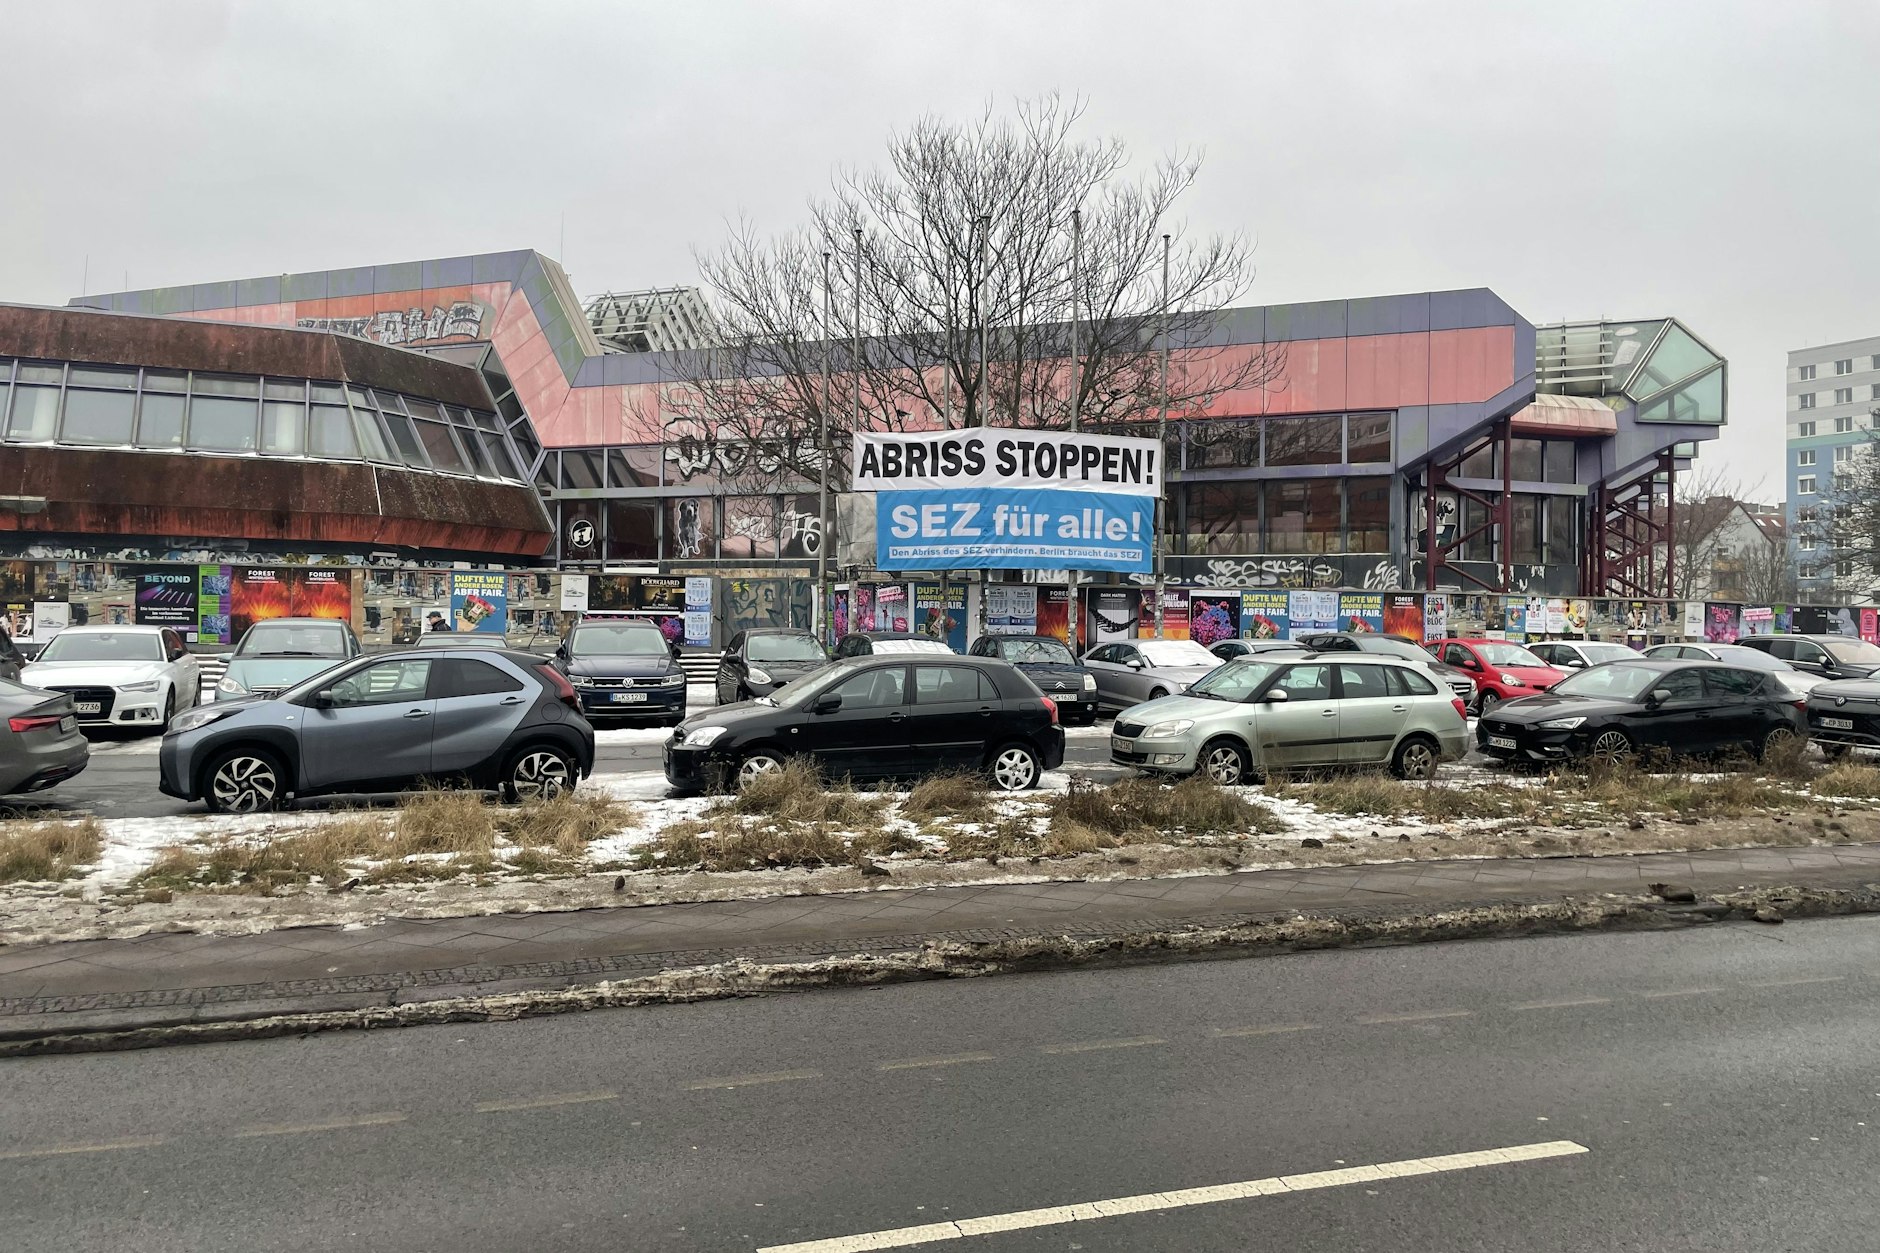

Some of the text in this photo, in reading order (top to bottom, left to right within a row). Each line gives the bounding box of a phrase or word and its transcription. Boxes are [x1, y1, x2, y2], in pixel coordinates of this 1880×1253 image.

[859, 439, 985, 478] ABRISS
[996, 440, 1154, 484] STOPPEN!
[891, 503, 1141, 542] SEZ für alle!
[912, 548, 940, 556] Abriss
[986, 547, 1037, 555] verhindern.
[1040, 548, 1065, 556] Berlin
[1069, 549, 1102, 557] braucht
[1104, 550, 1118, 558] das
[1121, 551, 1141, 560] SEZ!
[145, 575, 191, 583] BEYOND
[454, 575, 505, 584] DUFTE WIE
[641, 578, 680, 586] BODYGUARD
[453, 588, 505, 597] ABER FAIR.
[917, 587, 940, 595] DUFT
[1242, 594, 1273, 602] DUFTE
[1340, 595, 1366, 603] DUFTE
[1367, 596, 1381, 604] WIE
[1427, 597, 1443, 605] EAST
[917, 601, 965, 609] ABER AIR.
[1163, 599, 1188, 608] EVOLUCIÓN
[1242, 608, 1287, 616] ABER FAIR.
[1361, 609, 1381, 617] FAIR.
[1427, 618, 1443, 626] BLOC
